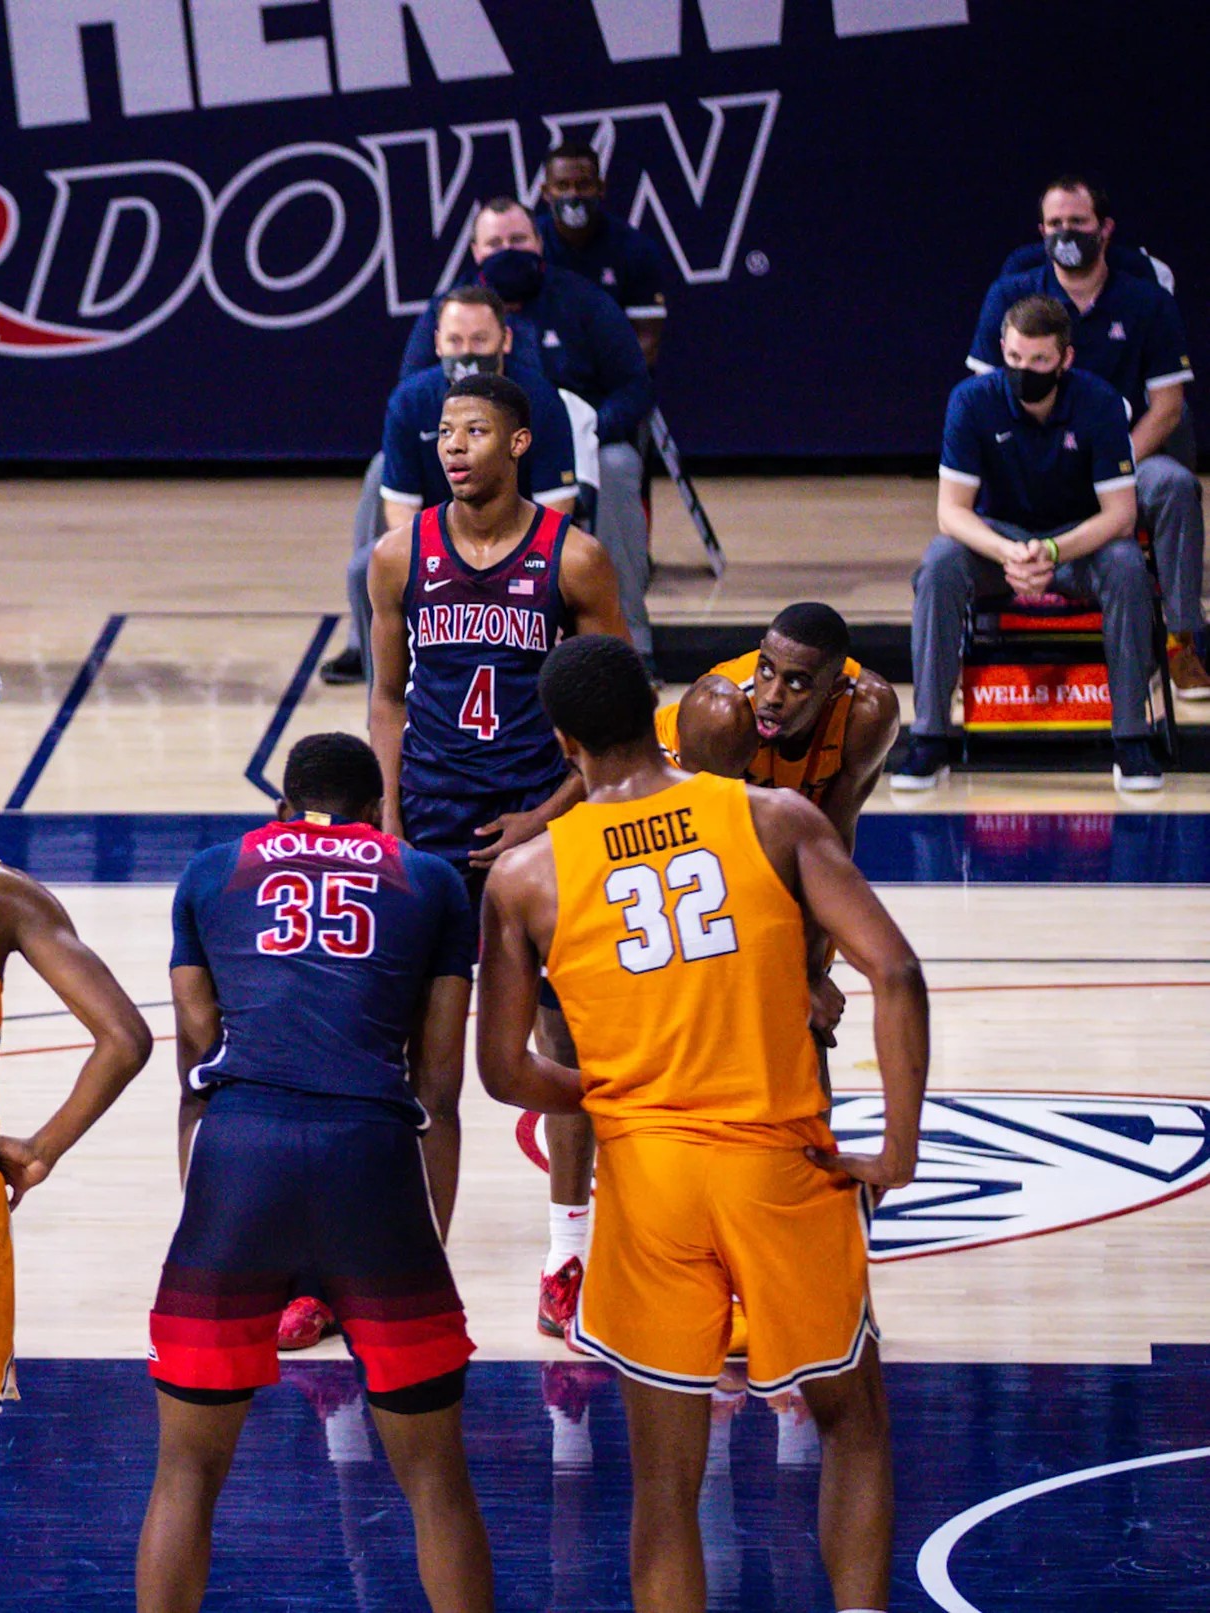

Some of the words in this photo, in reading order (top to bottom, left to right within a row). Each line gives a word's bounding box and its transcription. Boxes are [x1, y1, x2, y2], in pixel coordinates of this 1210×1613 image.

[417, 604, 547, 652] ARIZONA
[458, 664, 499, 741] 4
[972, 685, 1050, 705] WELLS
[1056, 683, 1111, 704] FARG
[256, 833, 383, 864] KOLOKO
[603, 806, 698, 861] ODIGIE
[256, 870, 379, 959] 35
[603, 847, 739, 976] 32
